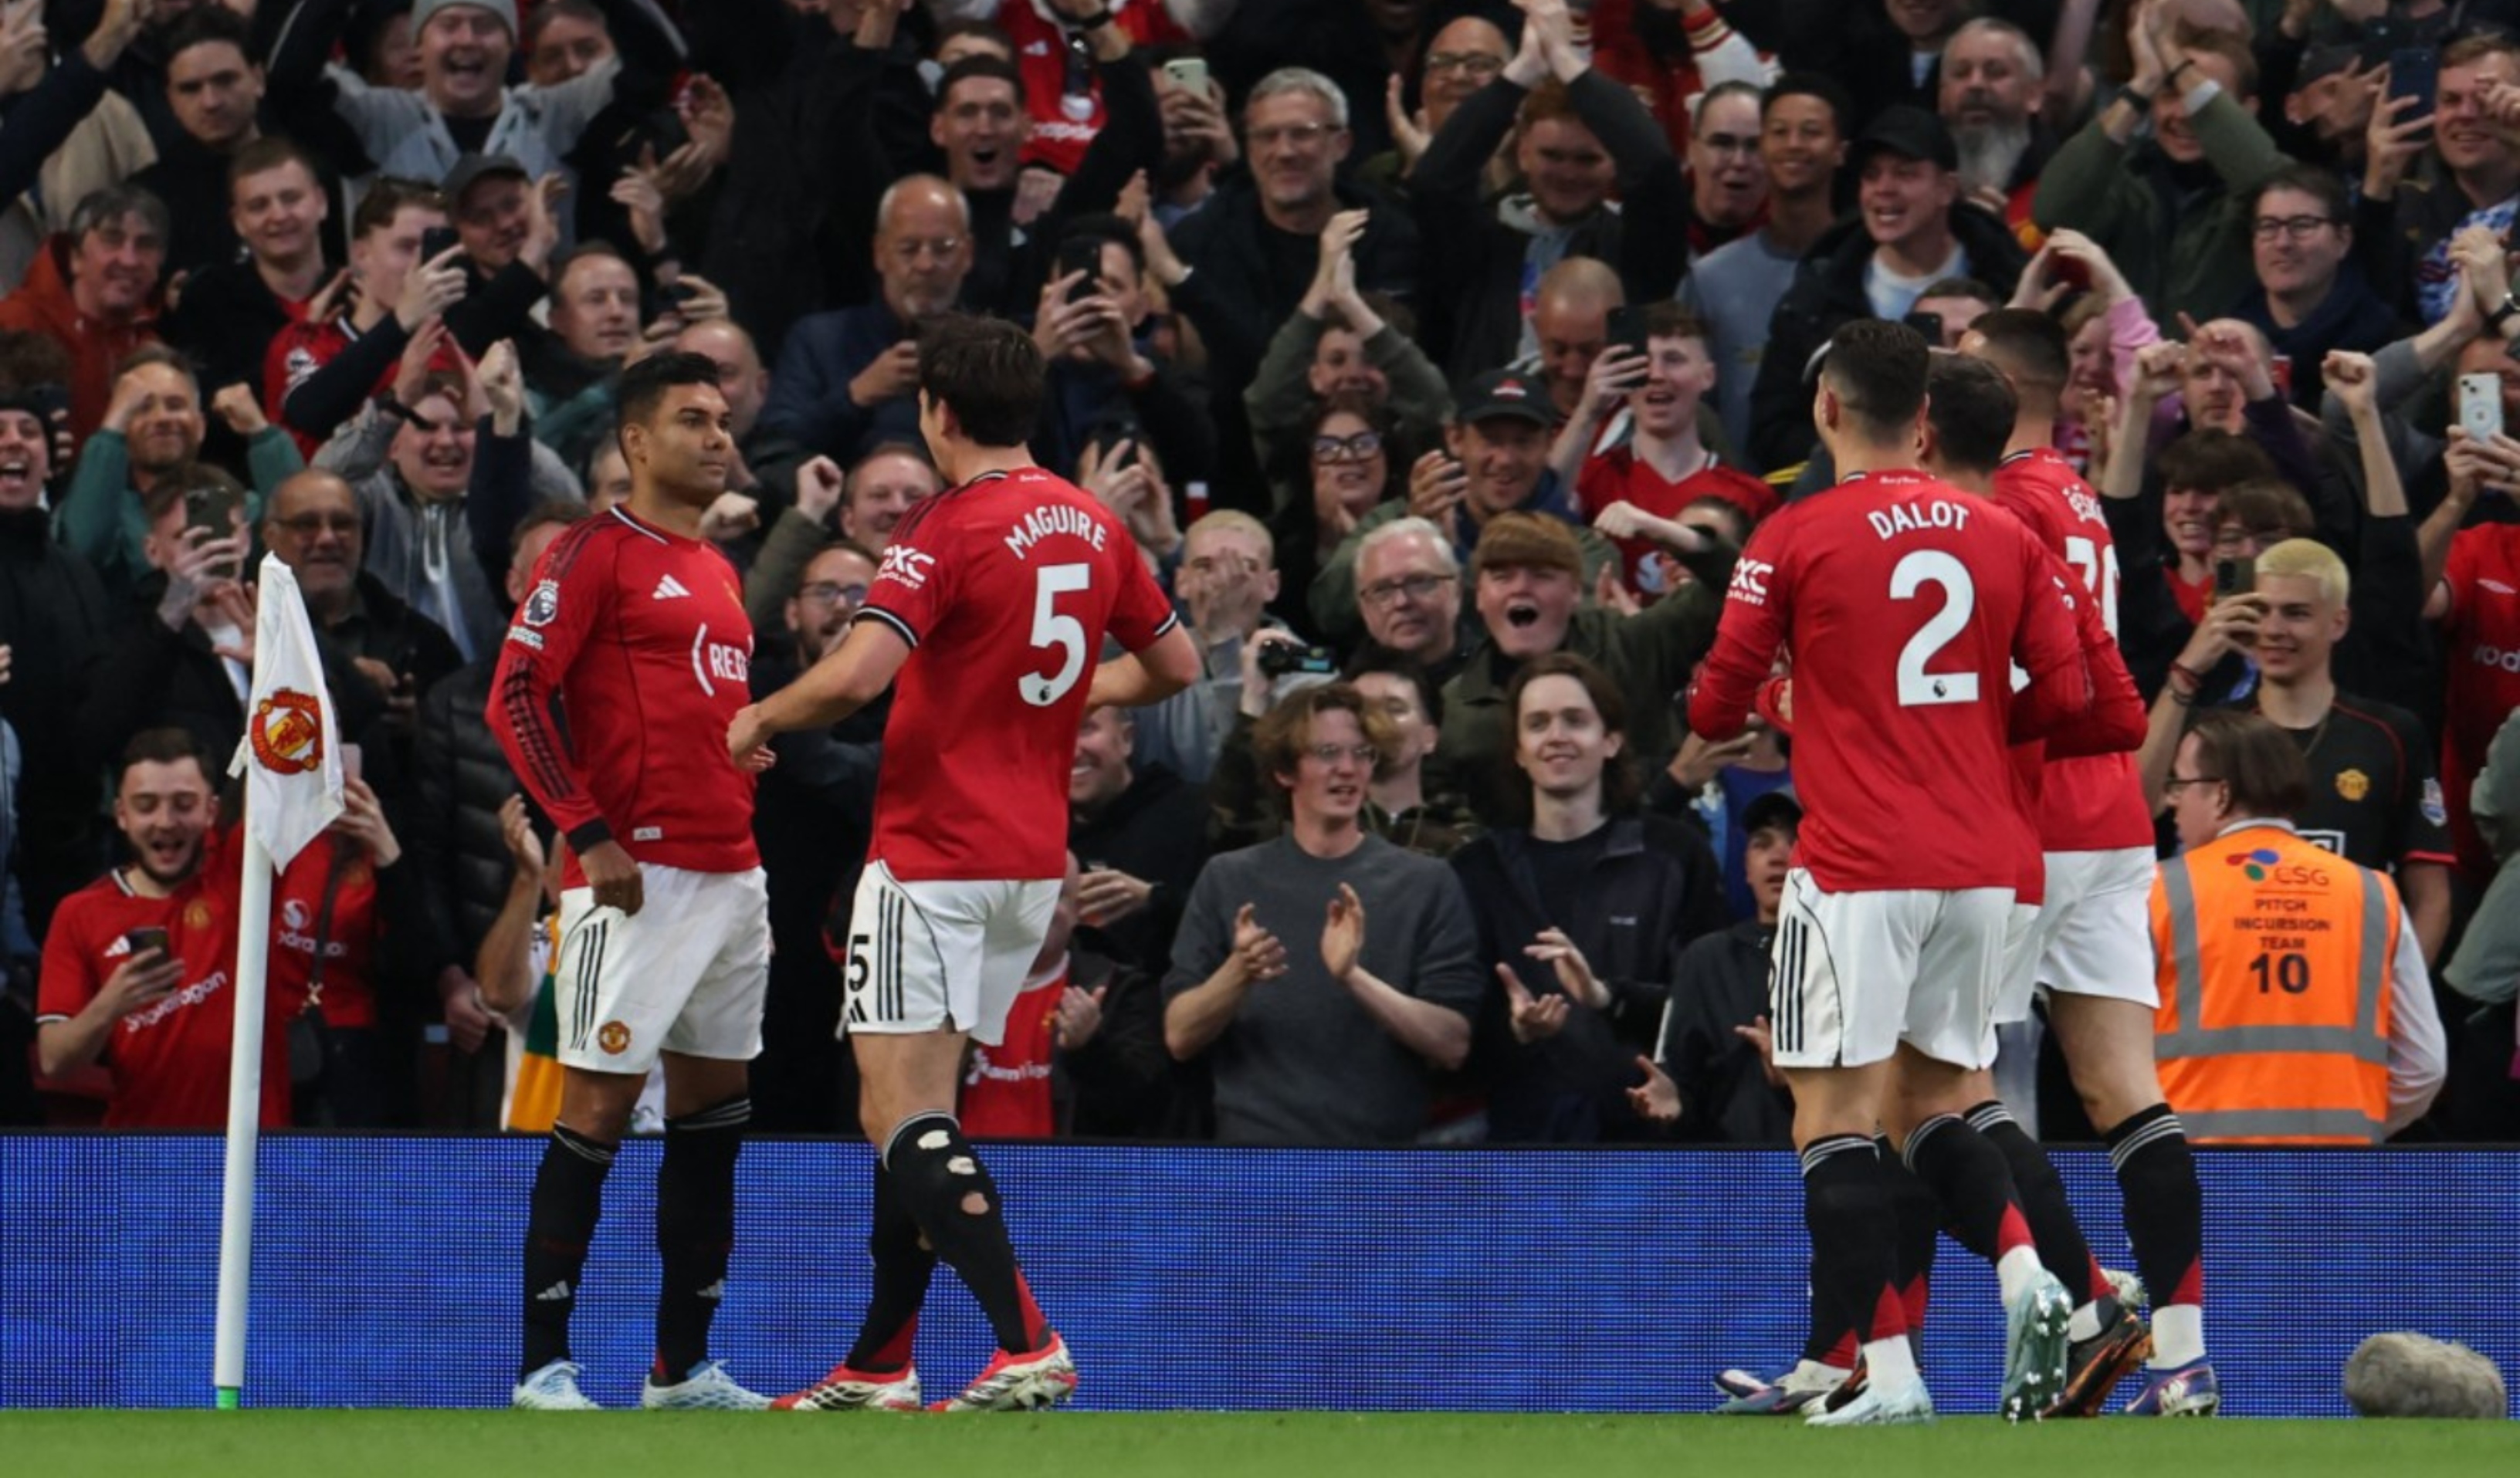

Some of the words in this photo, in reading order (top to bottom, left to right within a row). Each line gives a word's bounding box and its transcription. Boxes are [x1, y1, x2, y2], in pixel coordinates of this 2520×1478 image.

[1004, 505, 1107, 560] MAGUIRE
[1867, 500, 1970, 539] DALOT
[1730, 557, 1773, 596] XC
[1018, 563, 1090, 706] 5
[1889, 549, 1980, 706] 2
[2274, 866, 2330, 886] CSG
[2234, 917, 2331, 932] INCURSION
[2254, 899, 2308, 911] PITCH
[2259, 936, 2306, 949] TEAM
[848, 934, 870, 992] 5
[2250, 952, 2310, 994] 10
